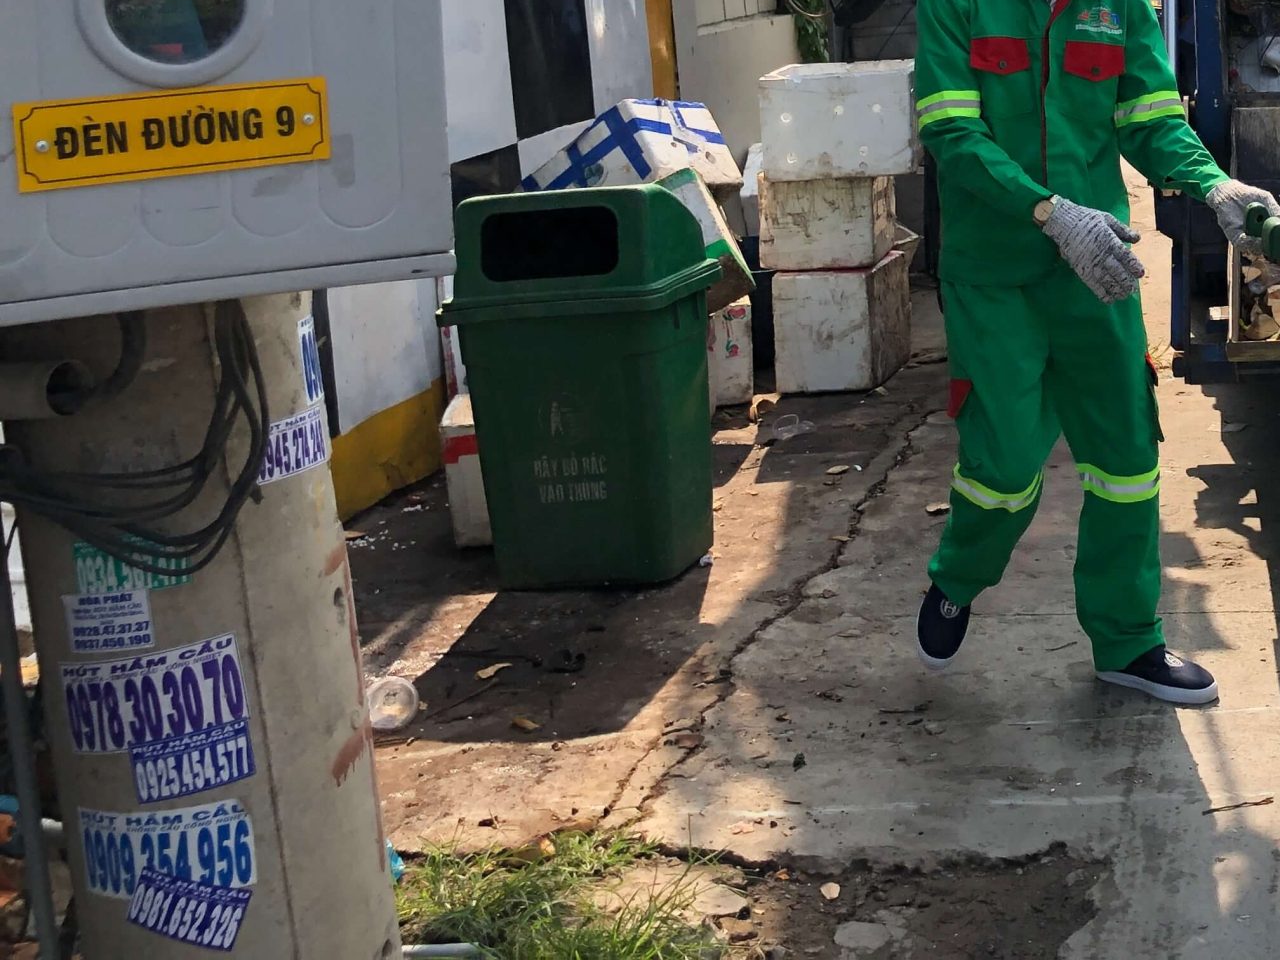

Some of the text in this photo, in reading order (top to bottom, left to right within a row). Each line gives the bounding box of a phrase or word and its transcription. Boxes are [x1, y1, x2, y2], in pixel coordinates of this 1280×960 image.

[54, 105, 296, 160] ĐÈN ĐƯỜNG 9
[110, 656, 168, 674] HẦM
[178, 637, 233, 659] CẦU
[65, 653, 244, 751] 0978.30.30.70
